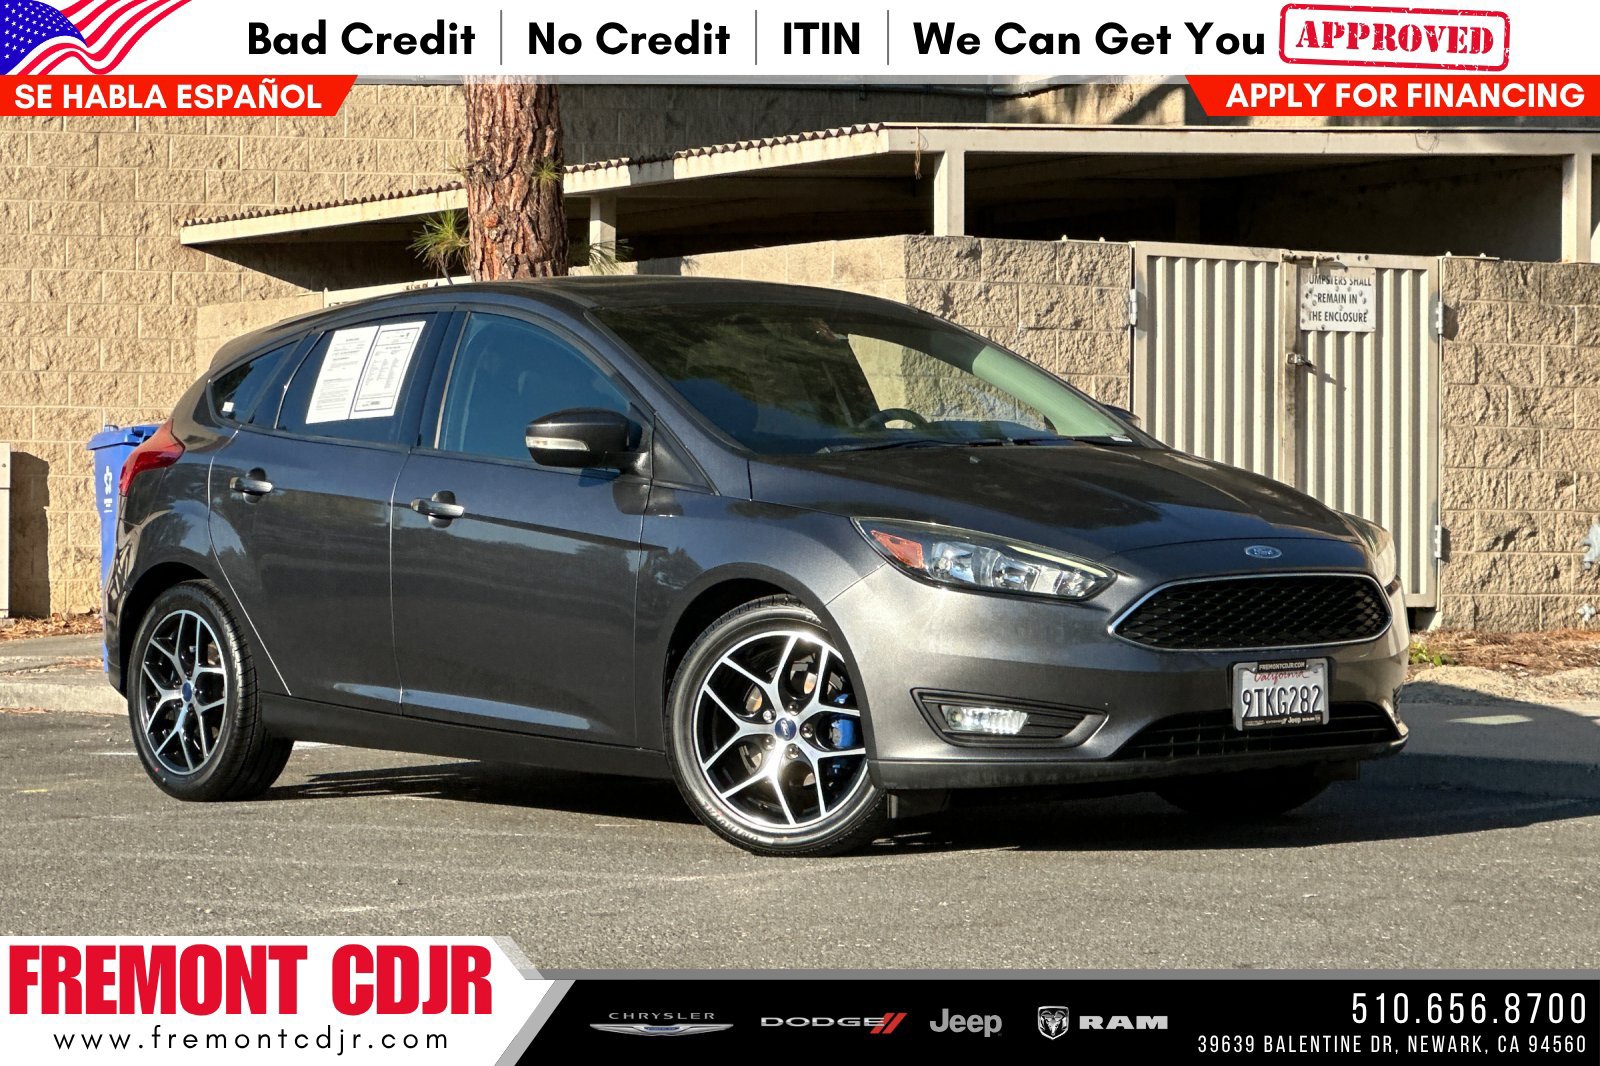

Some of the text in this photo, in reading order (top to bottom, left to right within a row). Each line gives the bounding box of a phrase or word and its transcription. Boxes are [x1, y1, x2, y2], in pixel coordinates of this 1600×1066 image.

[1349, 276, 1371, 286] SHALL
[1317, 292, 1358, 304] REMAIN IN
[1324, 311, 1368, 323] ENCLOSURE
[1254, 670, 1310, 685] California
[1242, 685, 1321, 718] 9TKG282
